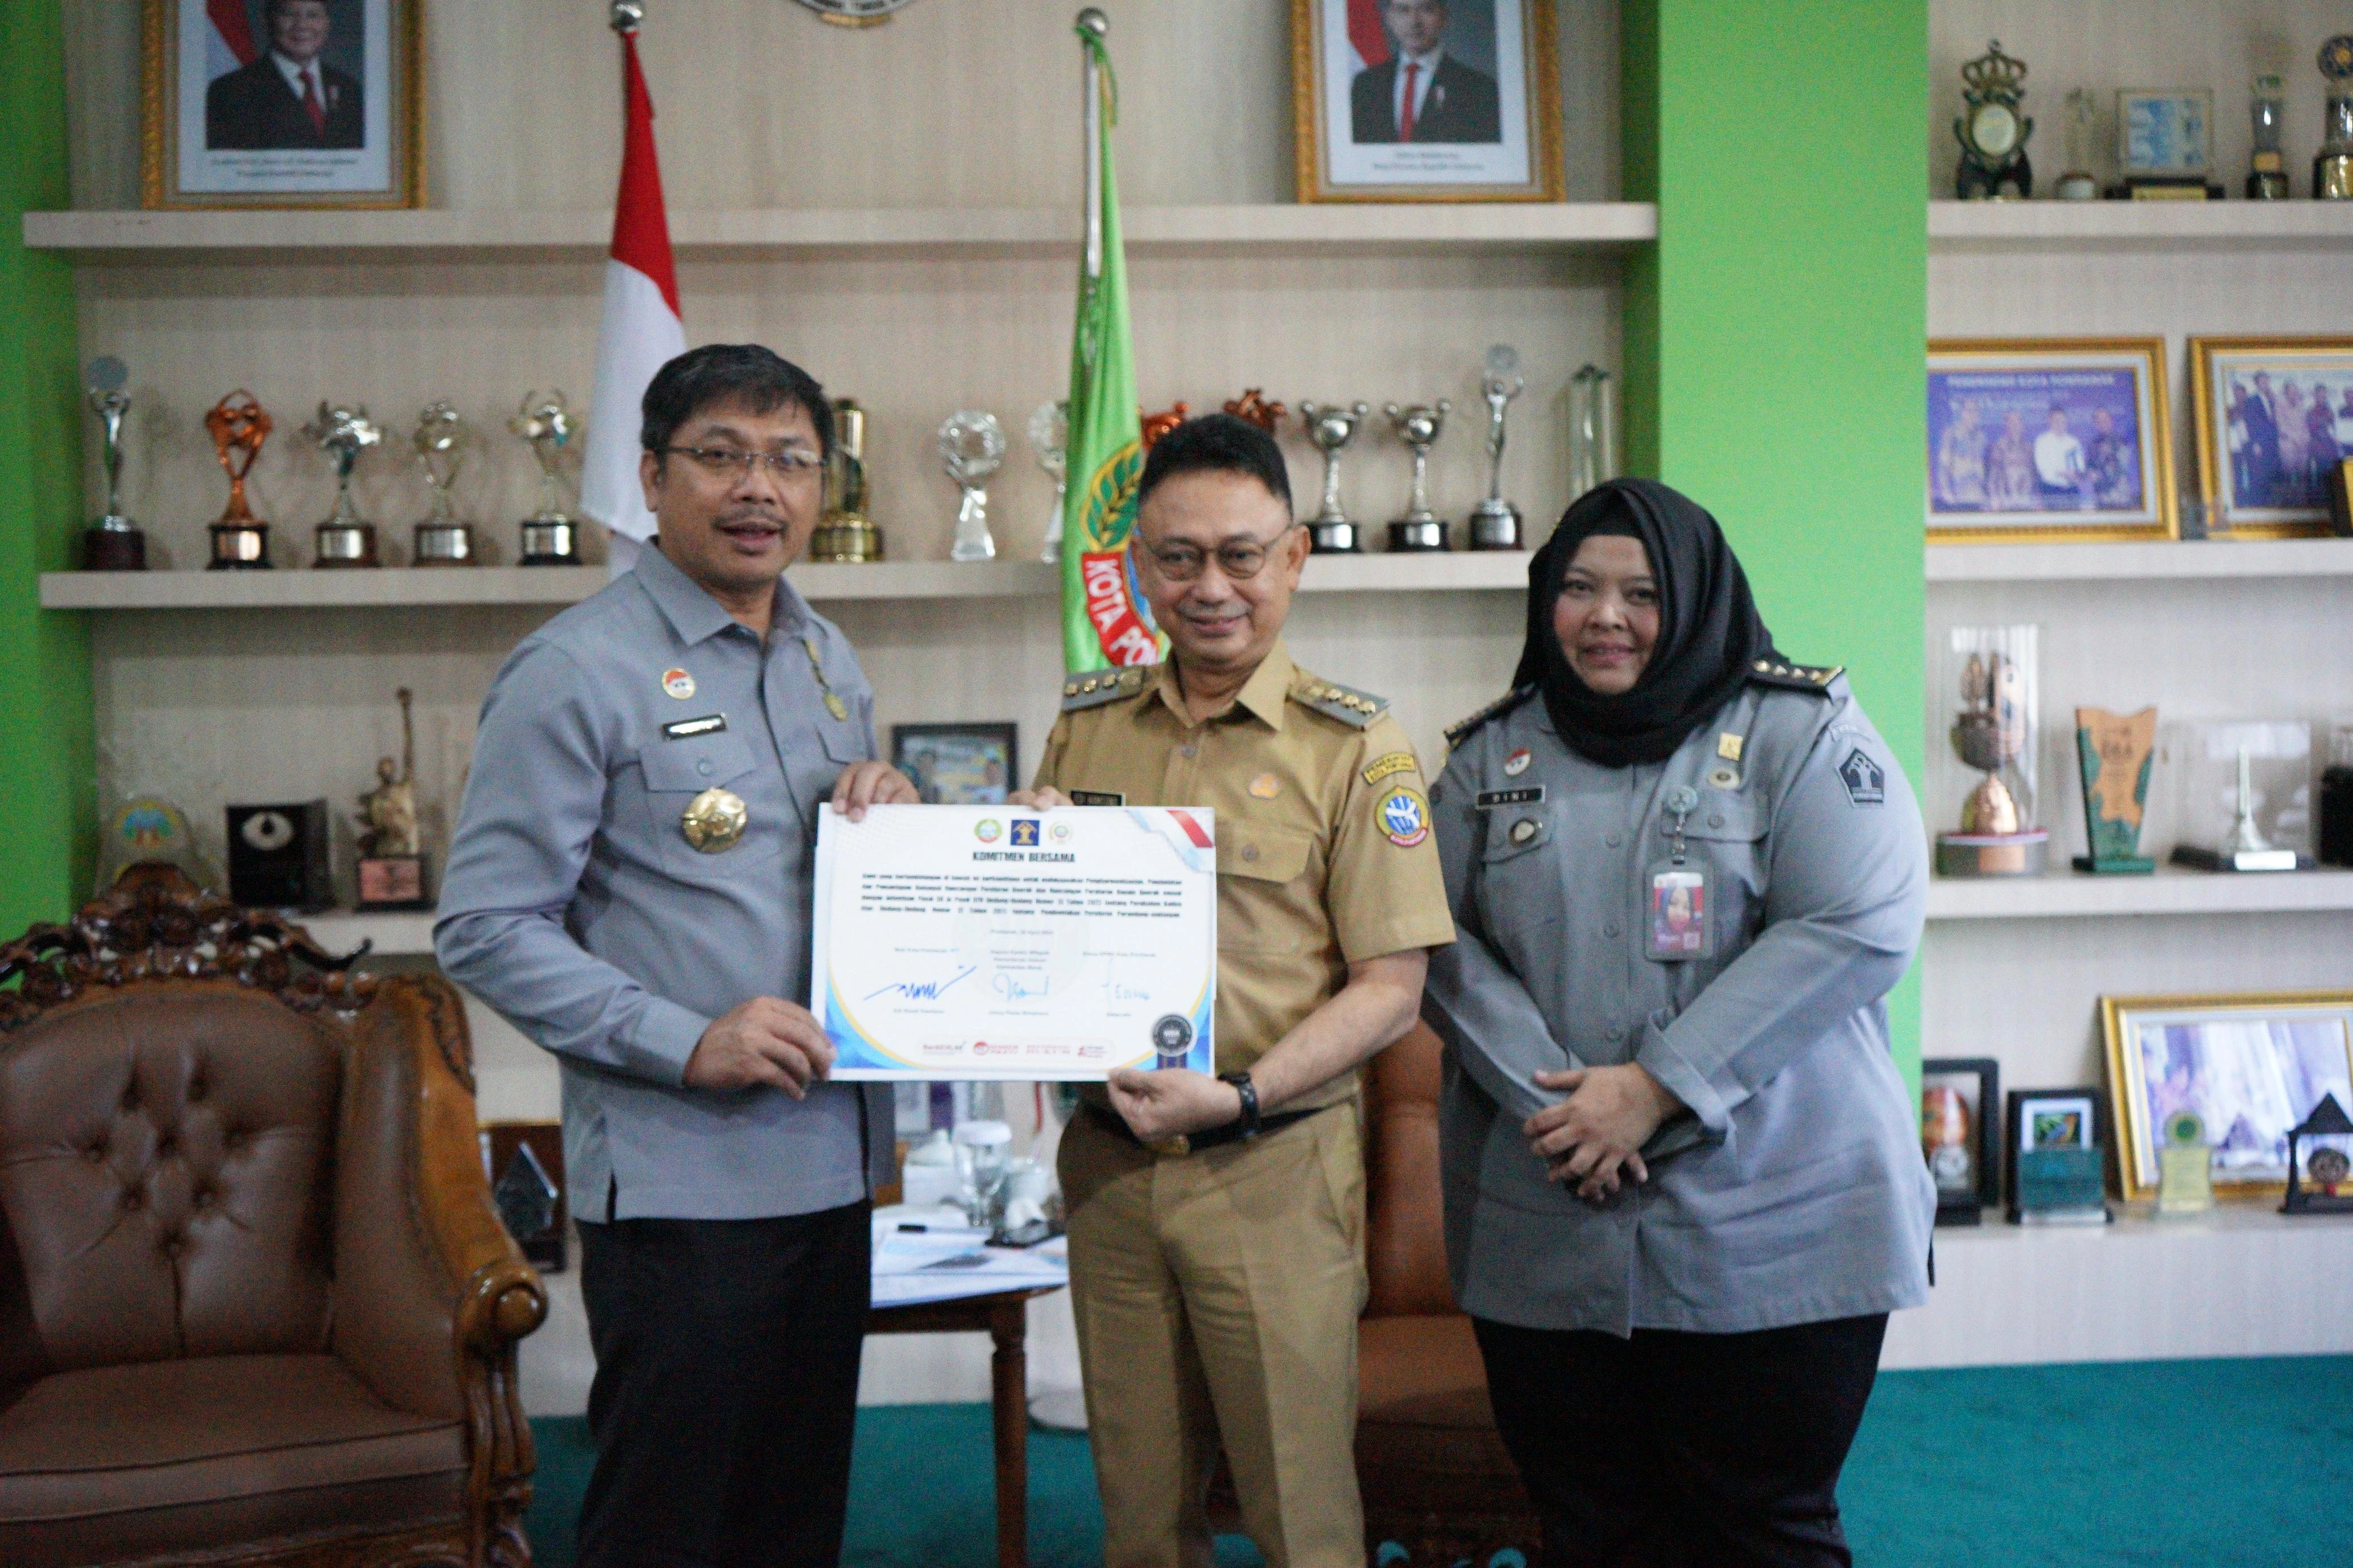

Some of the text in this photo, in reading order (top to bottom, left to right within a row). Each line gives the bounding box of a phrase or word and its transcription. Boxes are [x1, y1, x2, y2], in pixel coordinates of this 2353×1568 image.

[1085, 559, 1127, 633] KOTA
[973, 852, 1075, 862] KOMITMEN BERSAMA
